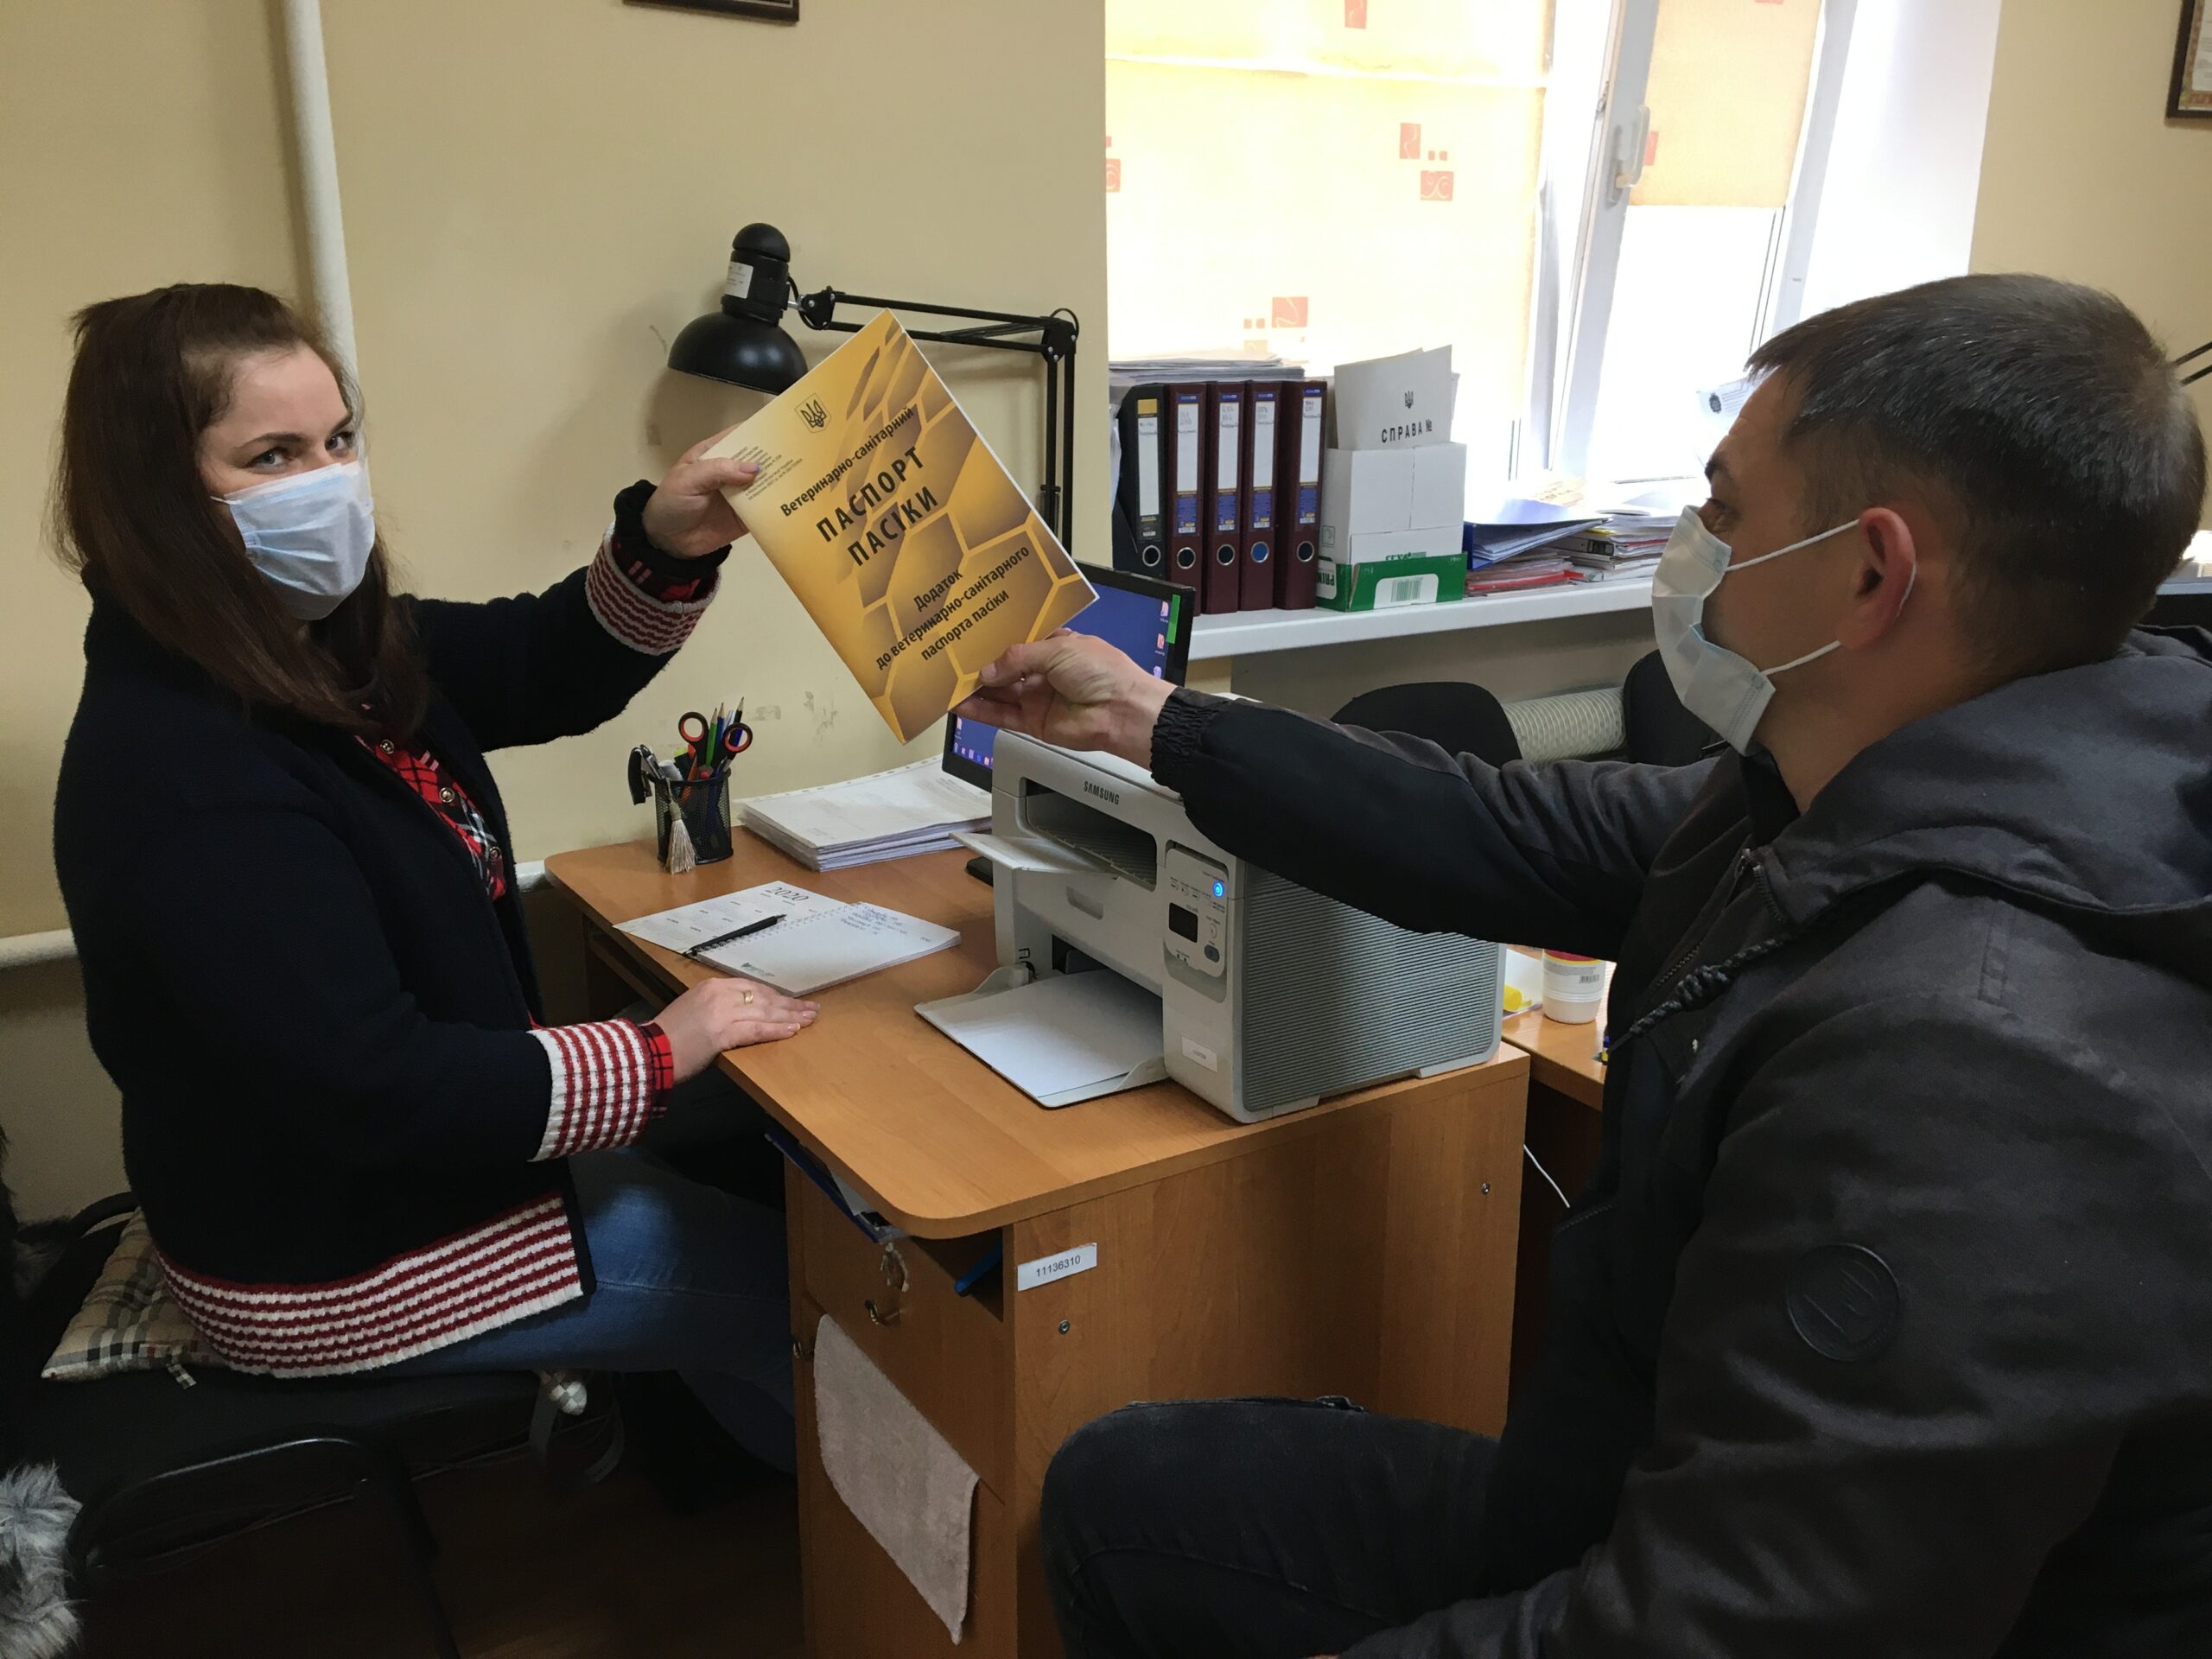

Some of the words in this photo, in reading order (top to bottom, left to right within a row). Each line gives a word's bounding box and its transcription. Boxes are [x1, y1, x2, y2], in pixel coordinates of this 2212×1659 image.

[1382, 421, 1422, 442] СПРАВА
[1425, 418, 1433, 432] №
[780, 406, 914, 517] Ветеринарно-санітарний
[816, 446, 924, 543] ПАСПОРТ
[847, 486, 938, 567] ПАСІКИ
[875, 652, 892, 671] до
[890, 547, 1030, 657] ветеринарно-санітарного
[913, 569, 963, 612] Додаток
[921, 618, 974, 661] паспорта
[971, 589, 1010, 622] пасіки
[1084, 780, 1120, 805] SAMSUNG
[765, 886, 810, 901] 2020
[1036, 1255, 1081, 1278] 11136310
